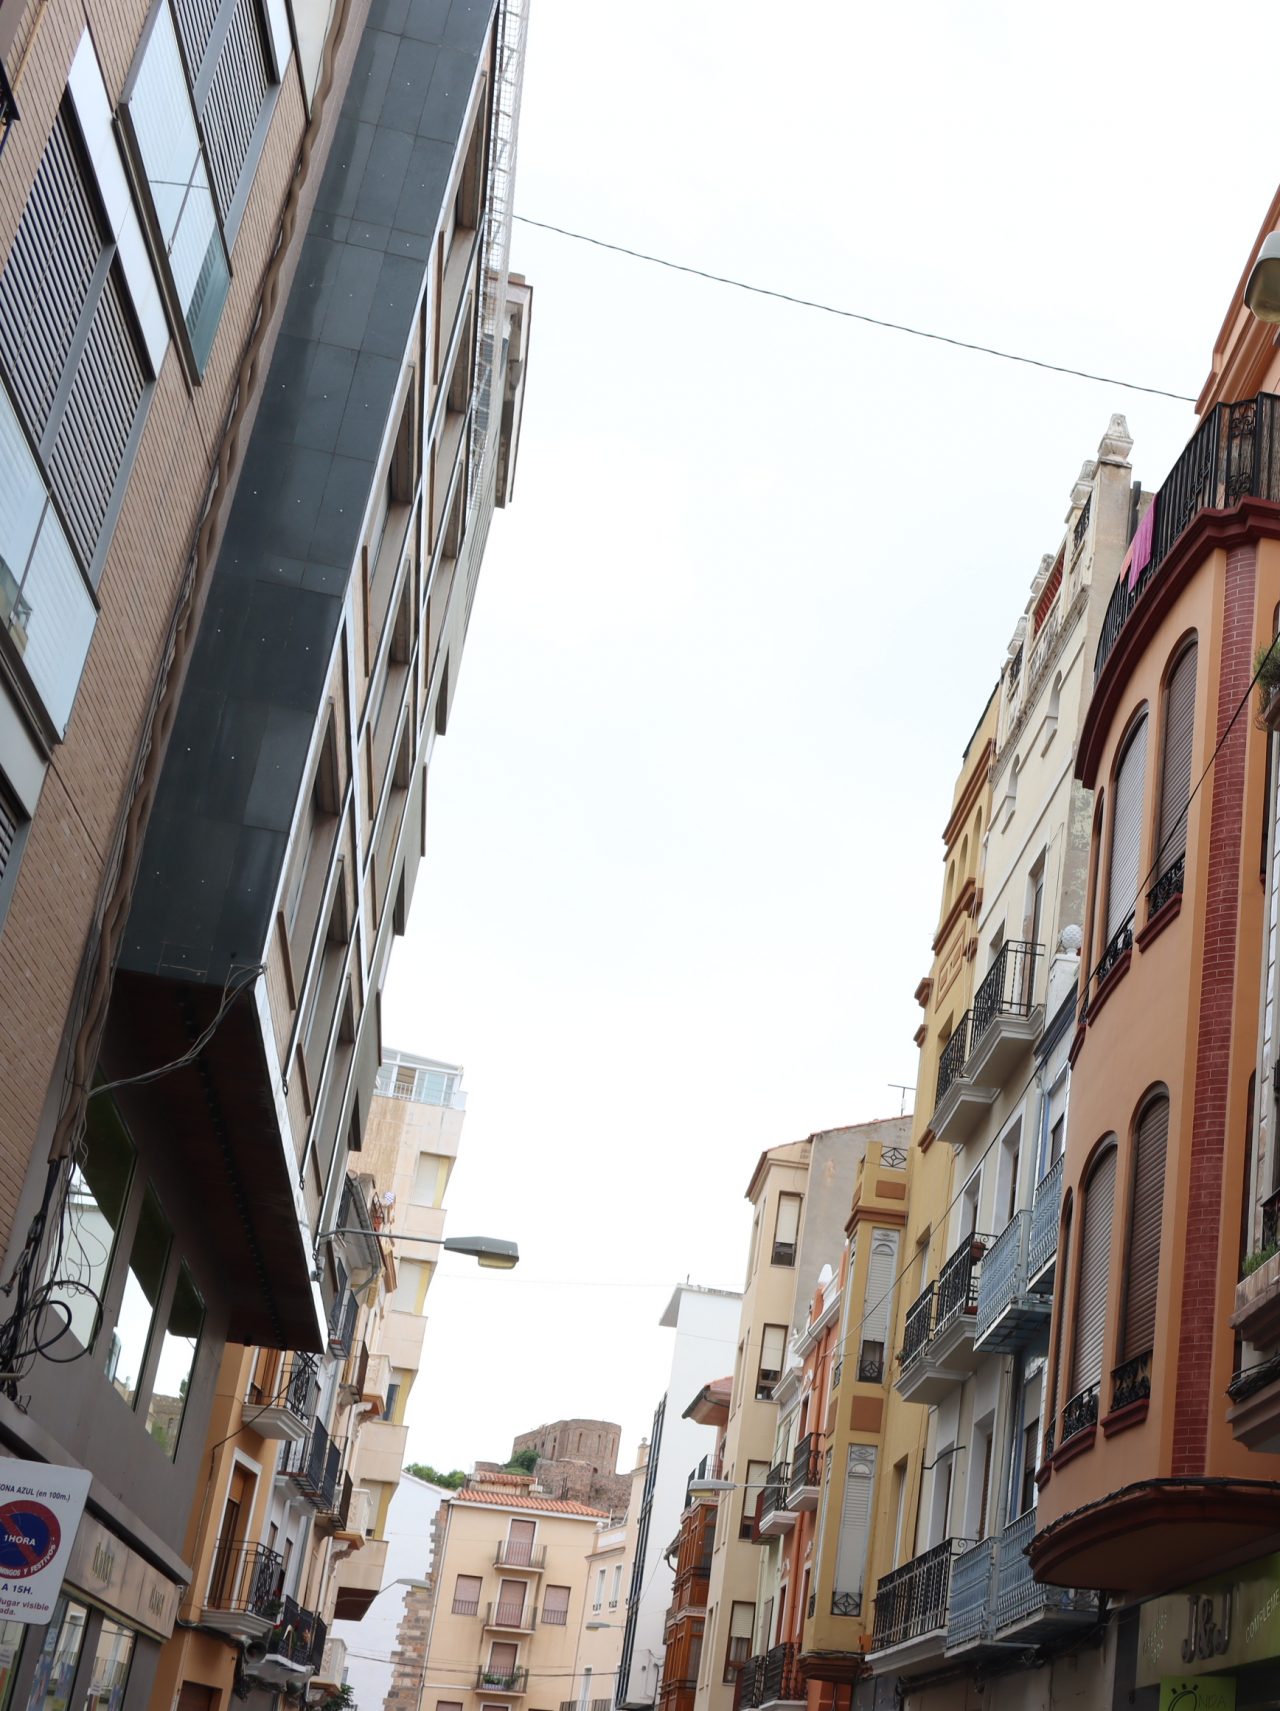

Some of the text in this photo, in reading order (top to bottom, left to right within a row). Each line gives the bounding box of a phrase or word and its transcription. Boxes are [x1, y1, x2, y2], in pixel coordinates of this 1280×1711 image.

[16, 1486, 35, 1496] AZUL
[36, 1489, 47, 1499] (en
[30, 1544, 56, 1574] FESTIVOS
[1, 1583, 33, 1595] A 15H.
[22, 1601, 50, 1612] visible
[1181, 1582, 1234, 1664] J&J
